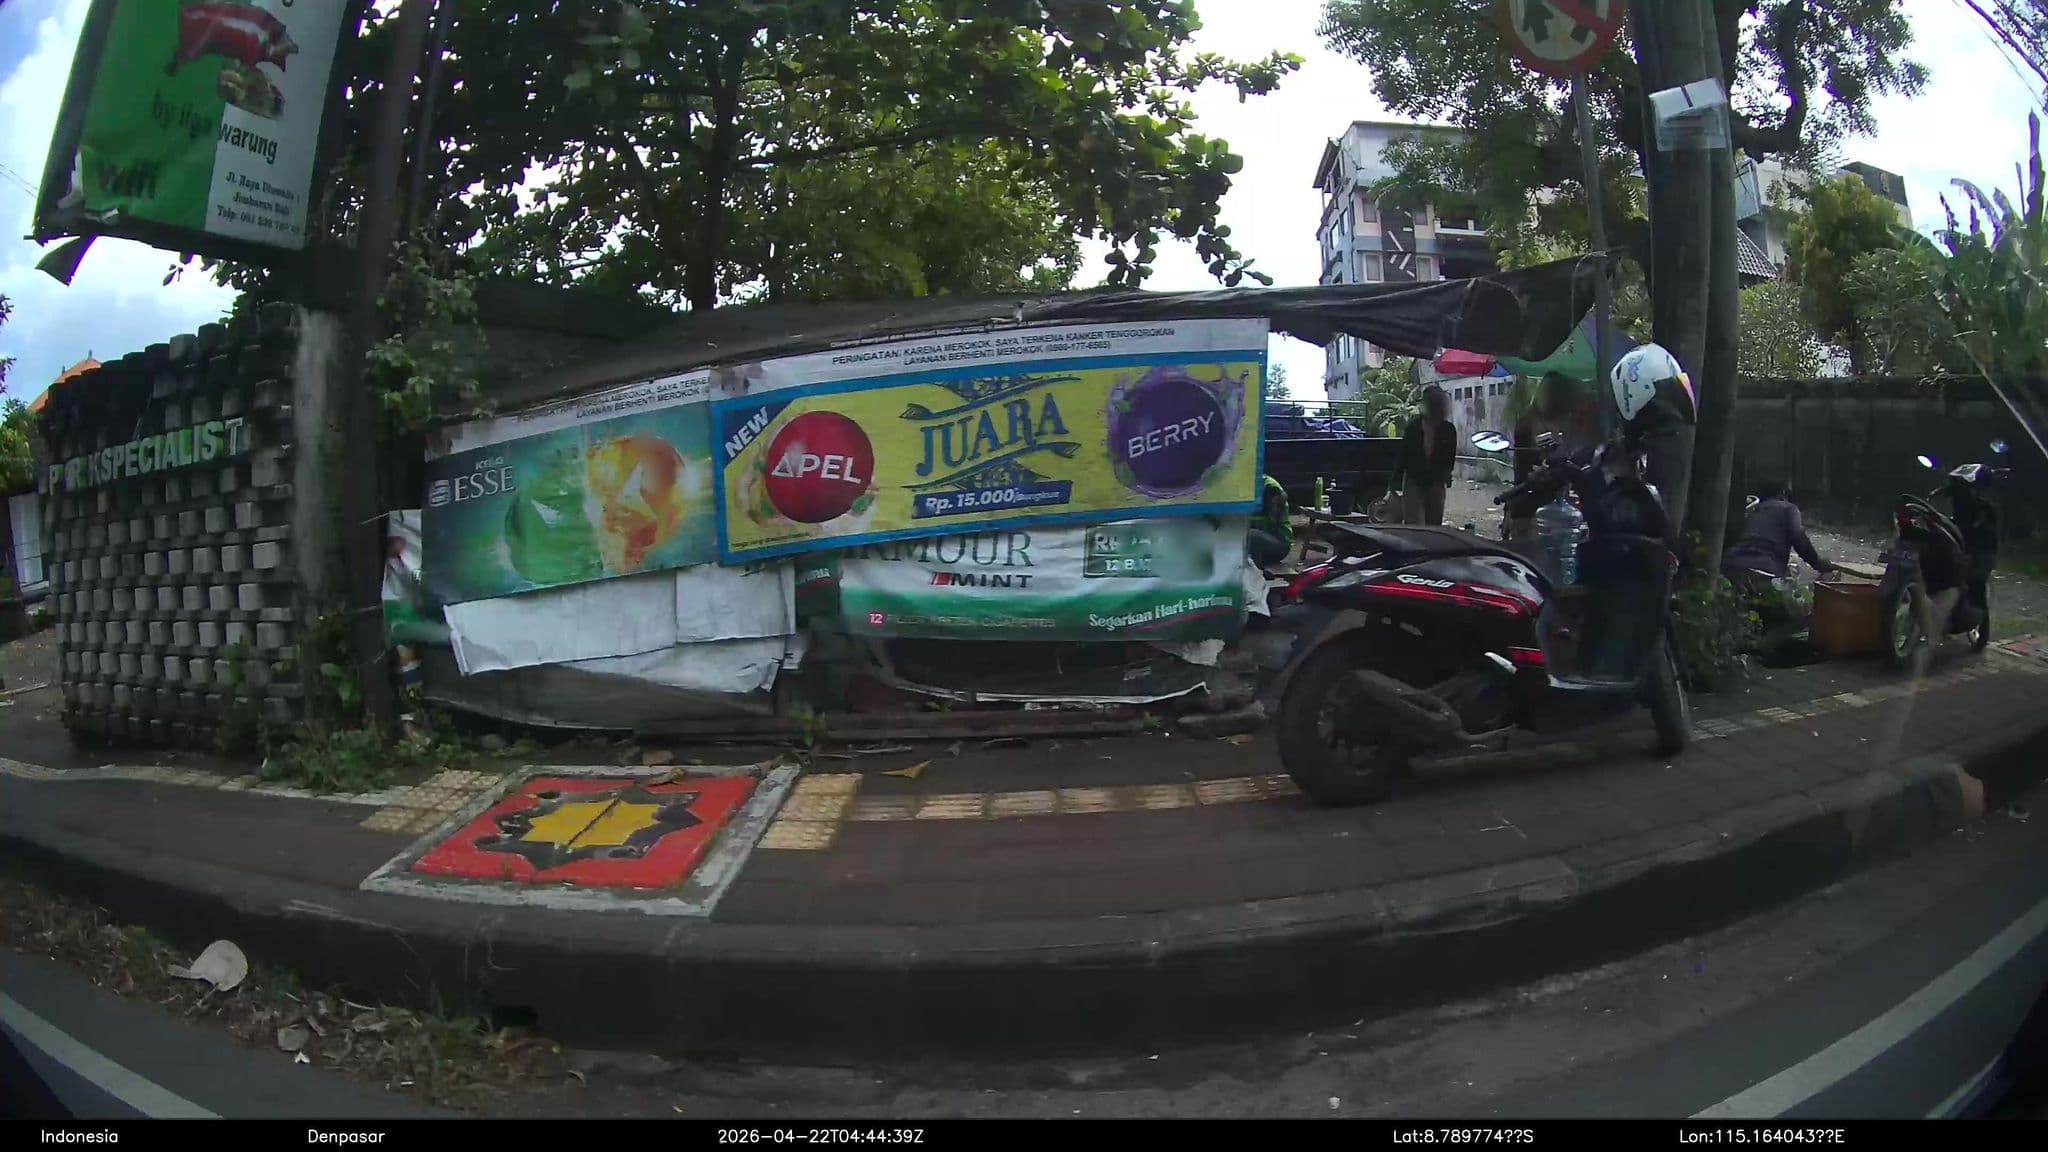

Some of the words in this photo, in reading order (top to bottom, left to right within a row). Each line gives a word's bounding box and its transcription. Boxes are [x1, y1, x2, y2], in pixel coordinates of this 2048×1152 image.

[219, 123, 278, 165] warung
[904, 345, 943, 356] KARENA
[995, 337, 1020, 347] SAYA
[1021, 332, 1064, 345] TERKENA
[1066, 330, 1104, 341] KANKER
[904, 354, 947, 366] LAYANAN
[948, 349, 995, 361] BERHENTI
[996, 345, 1043, 357] MEROKOK
[577, 404, 613, 419] LAYANAN
[615, 395, 654, 411] BERHENTI
[657, 388, 700, 402] MEROKOK
[724, 406, 771, 458] NEW
[915, 392, 1070, 476] JUARA
[1127, 411, 1215, 459] BERRY
[454, 465, 515, 502] ESSE
[771, 452, 862, 484] APEL
[925, 496, 953, 514] Rp.
[950, 572, 1034, 588] MINT
[869, 613, 883, 624] 12
[1088, 610, 1153, 632] Segarkan
